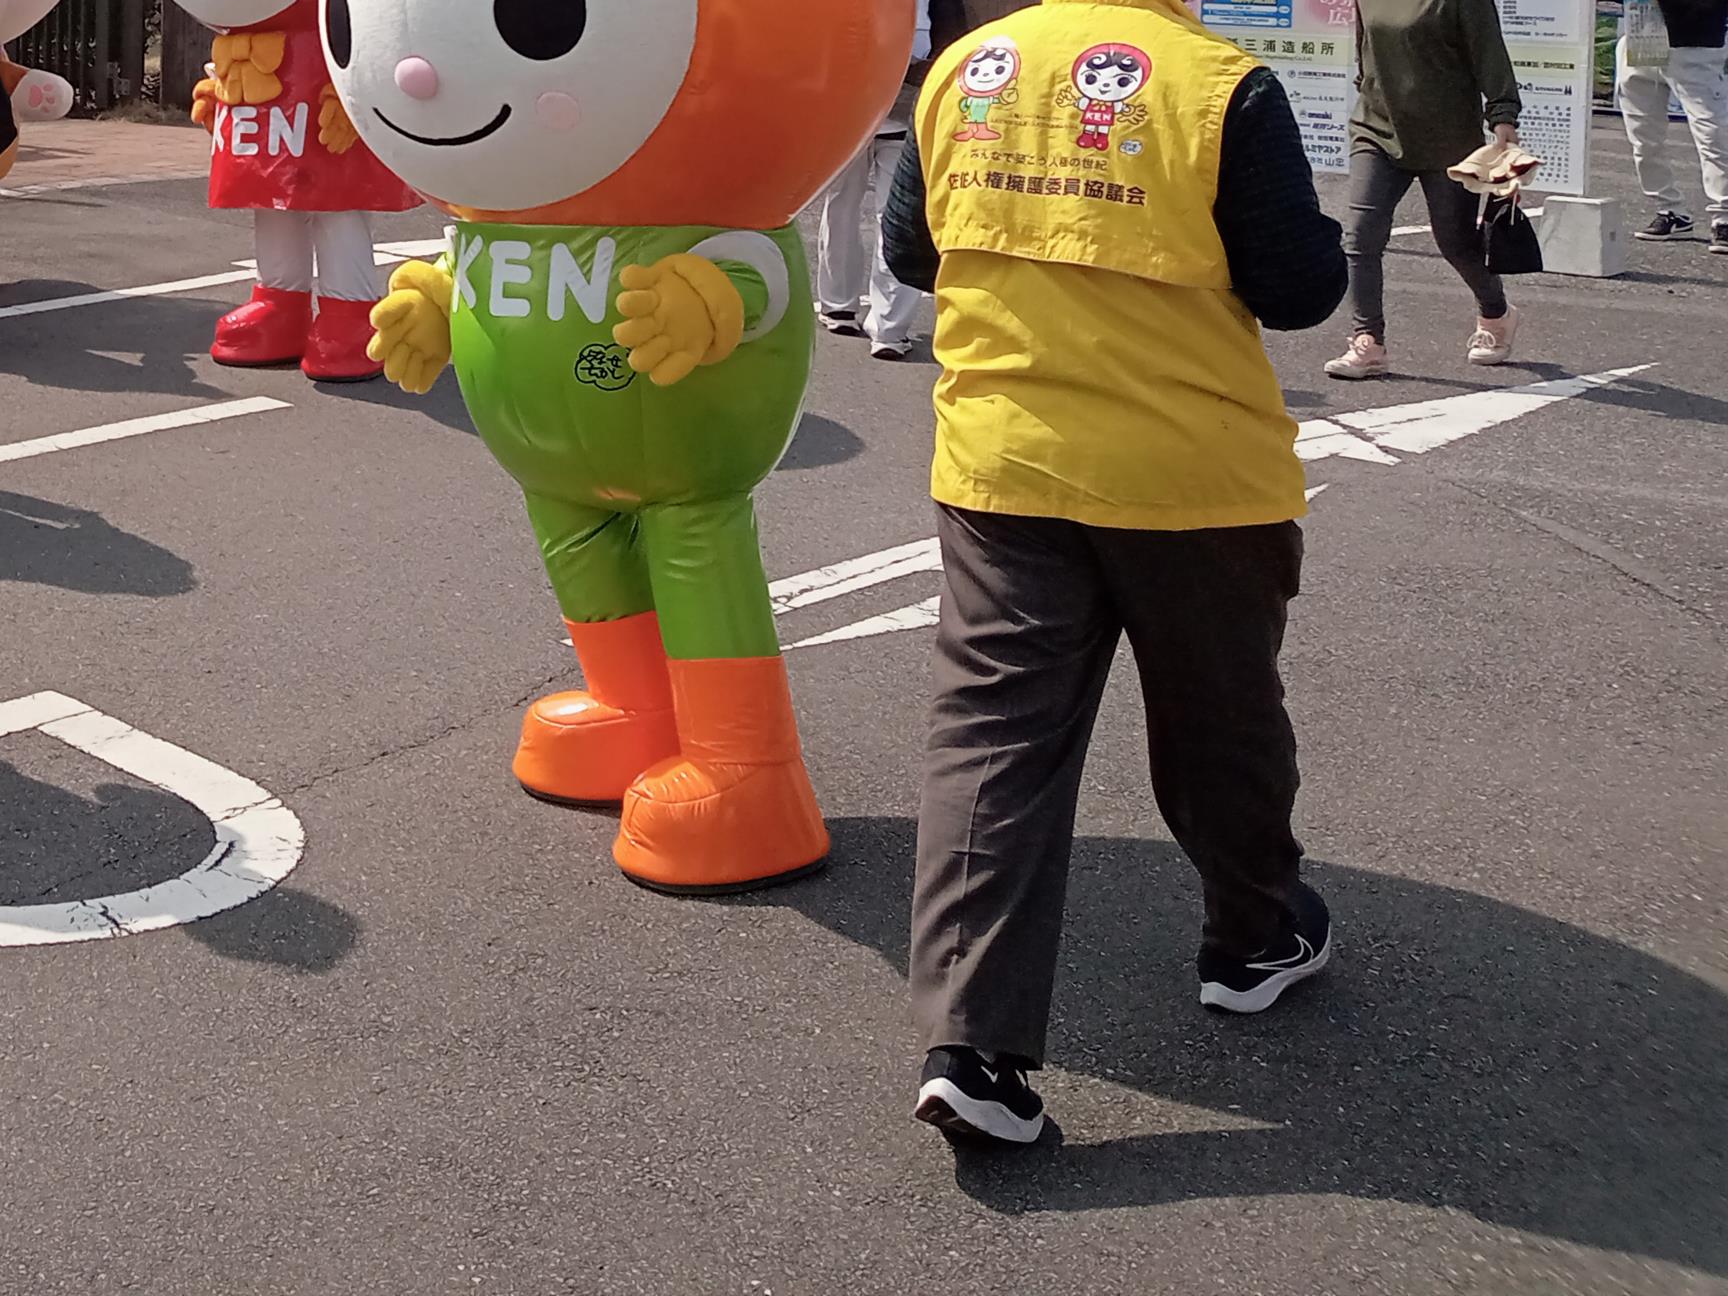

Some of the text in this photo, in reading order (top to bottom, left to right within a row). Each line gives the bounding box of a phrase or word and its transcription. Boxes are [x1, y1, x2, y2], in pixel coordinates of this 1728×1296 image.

[1227, 38, 1334, 56] 三浦造船所
[1085, 111, 1112, 122] KEN
[210, 102, 309, 157] KEN
[1304, 144, 1342, 155] ルミヤストア
[450, 232, 616, 324] KEN
